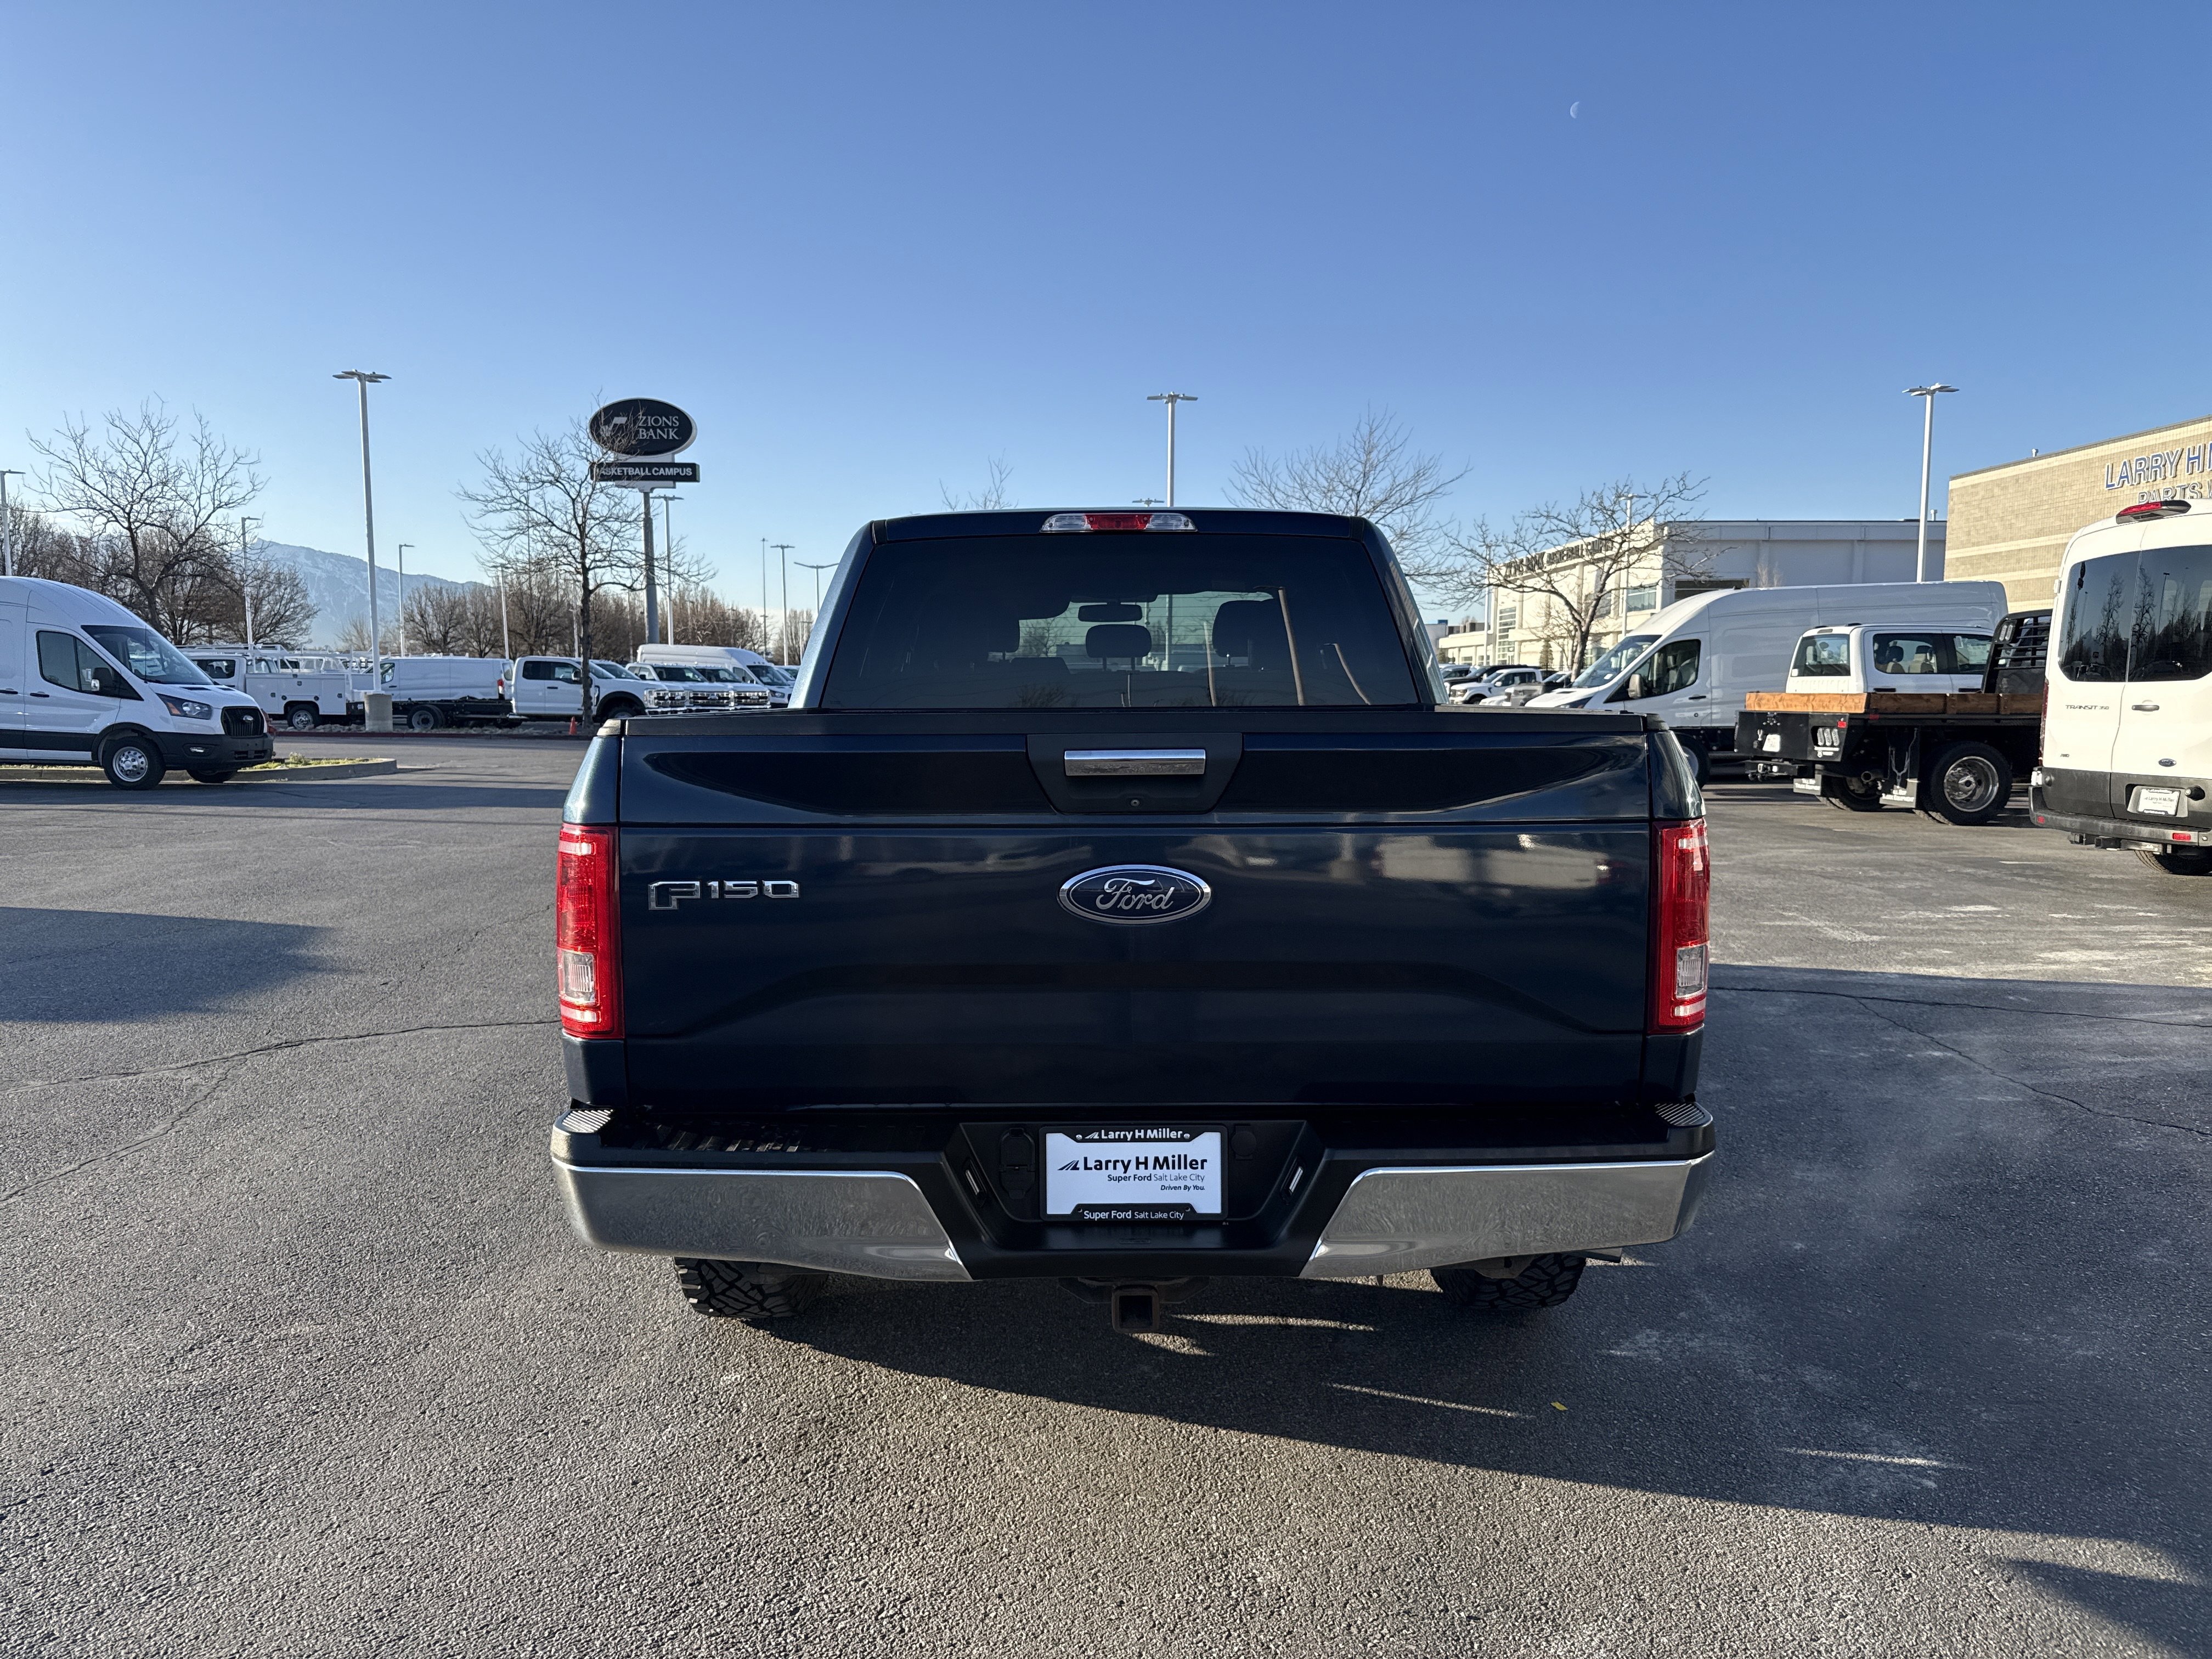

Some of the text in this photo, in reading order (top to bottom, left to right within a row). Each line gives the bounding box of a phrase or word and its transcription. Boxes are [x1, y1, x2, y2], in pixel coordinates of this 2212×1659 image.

[638, 415, 679, 427] ZIONS
[639, 428, 679, 439] BANK
[652, 467, 692, 476] CAMPUS
[2104, 447, 2182, 490] LARRY
[2186, 443, 2204, 475] H
[1096, 878, 1175, 910] Ford
[1101, 1128, 1183, 1141] Larry H Miller
[1084, 1154, 1207, 1173] Larry H Miller
[1107, 1173, 1205, 1183] Super Ford Salt Lake City
[1084, 1210, 1184, 1221] Super Ford Salt Lake City
